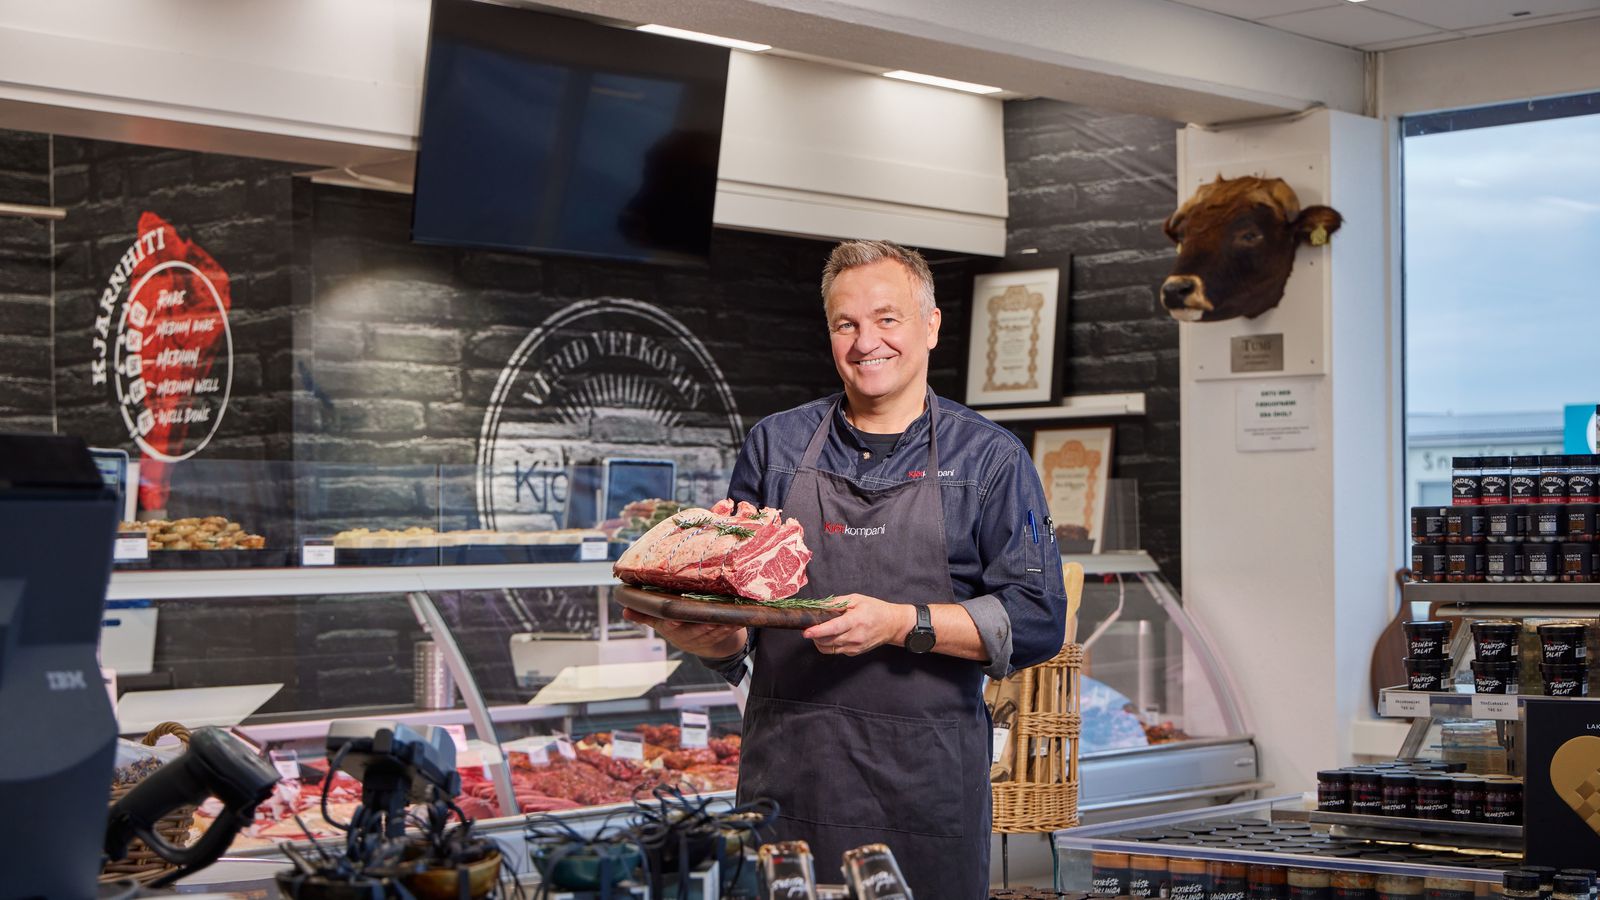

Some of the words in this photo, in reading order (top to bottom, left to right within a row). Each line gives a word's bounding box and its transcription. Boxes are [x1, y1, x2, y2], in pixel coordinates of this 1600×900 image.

[92, 226, 165, 386] KJARNHITI
[46, 670, 88, 690] IBM
[1412, 682, 1431, 690] SALAT
[1552, 688, 1573, 696] SALAT
